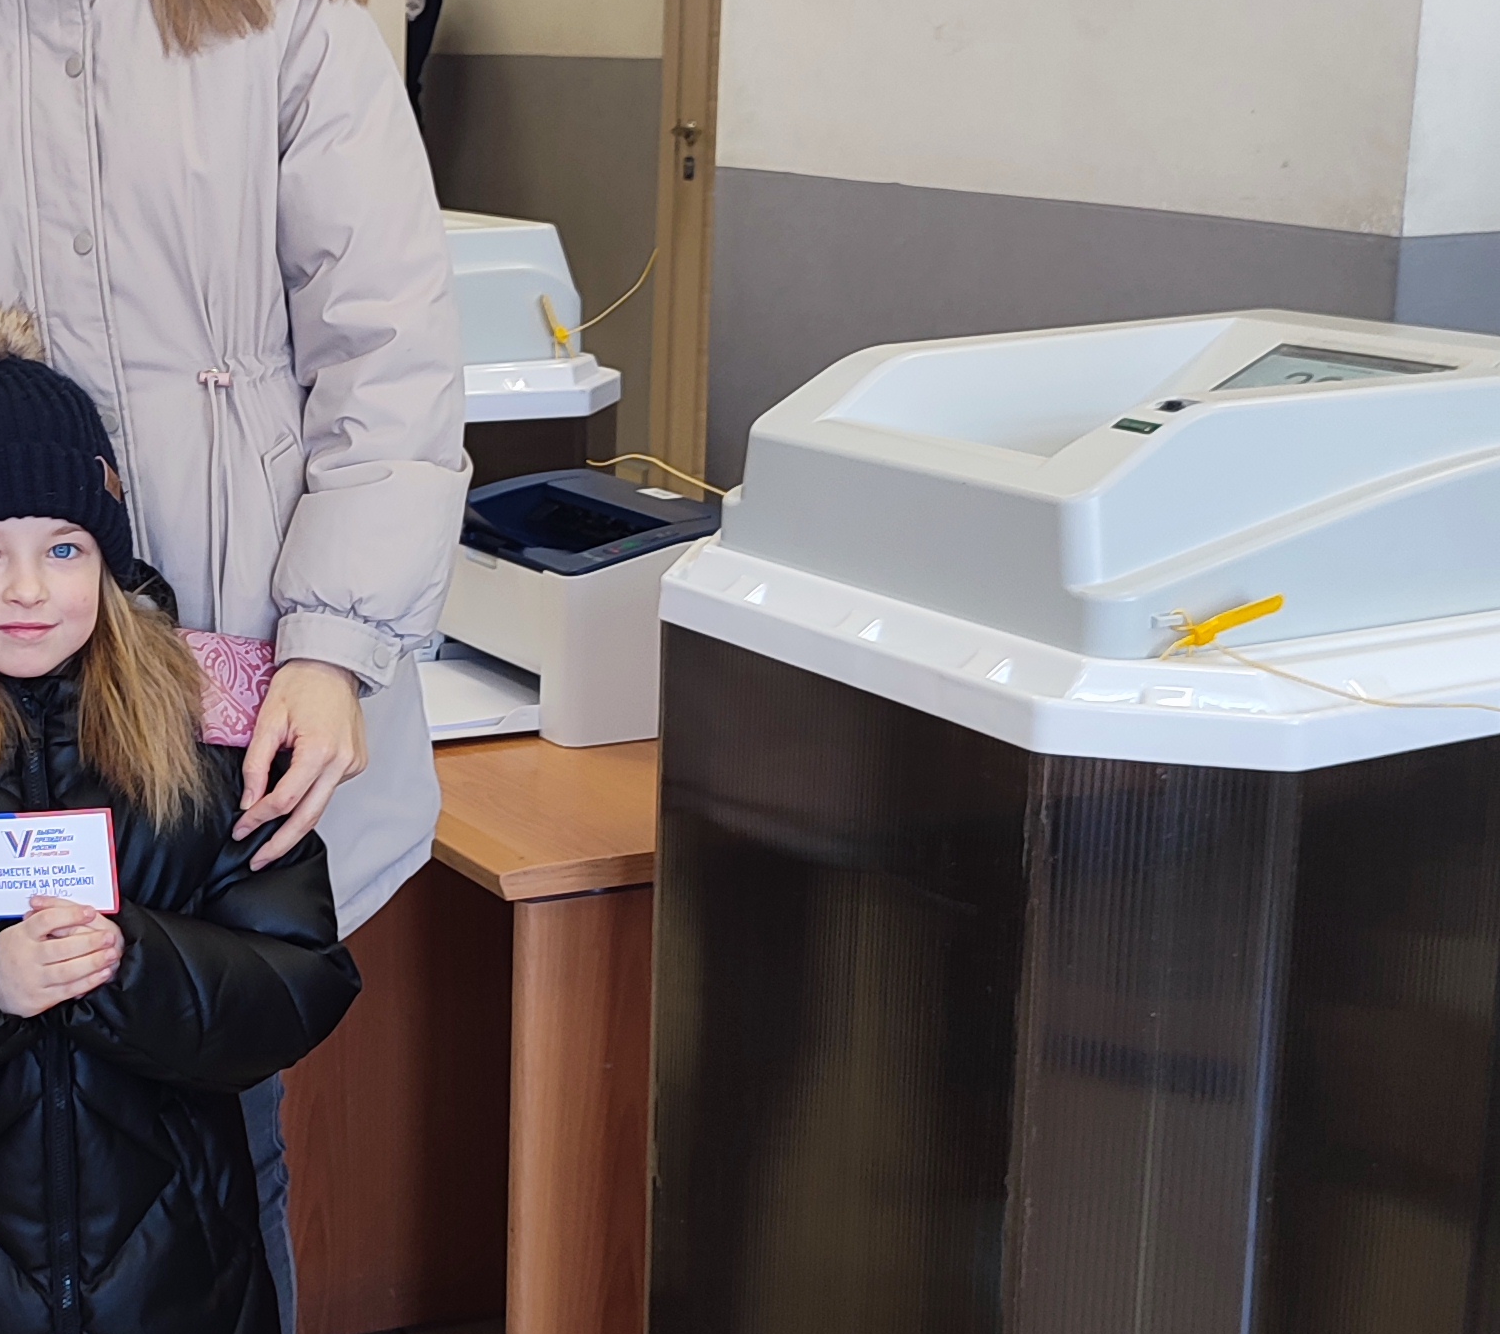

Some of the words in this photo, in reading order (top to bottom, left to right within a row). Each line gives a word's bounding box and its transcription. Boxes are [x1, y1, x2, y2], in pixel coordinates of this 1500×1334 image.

[33, 866, 50, 876] МЫ
[51, 864, 77, 875] СИЛА
[38, 878, 50, 888] ЗА
[52, 876, 94, 888] РОССИЮ!
